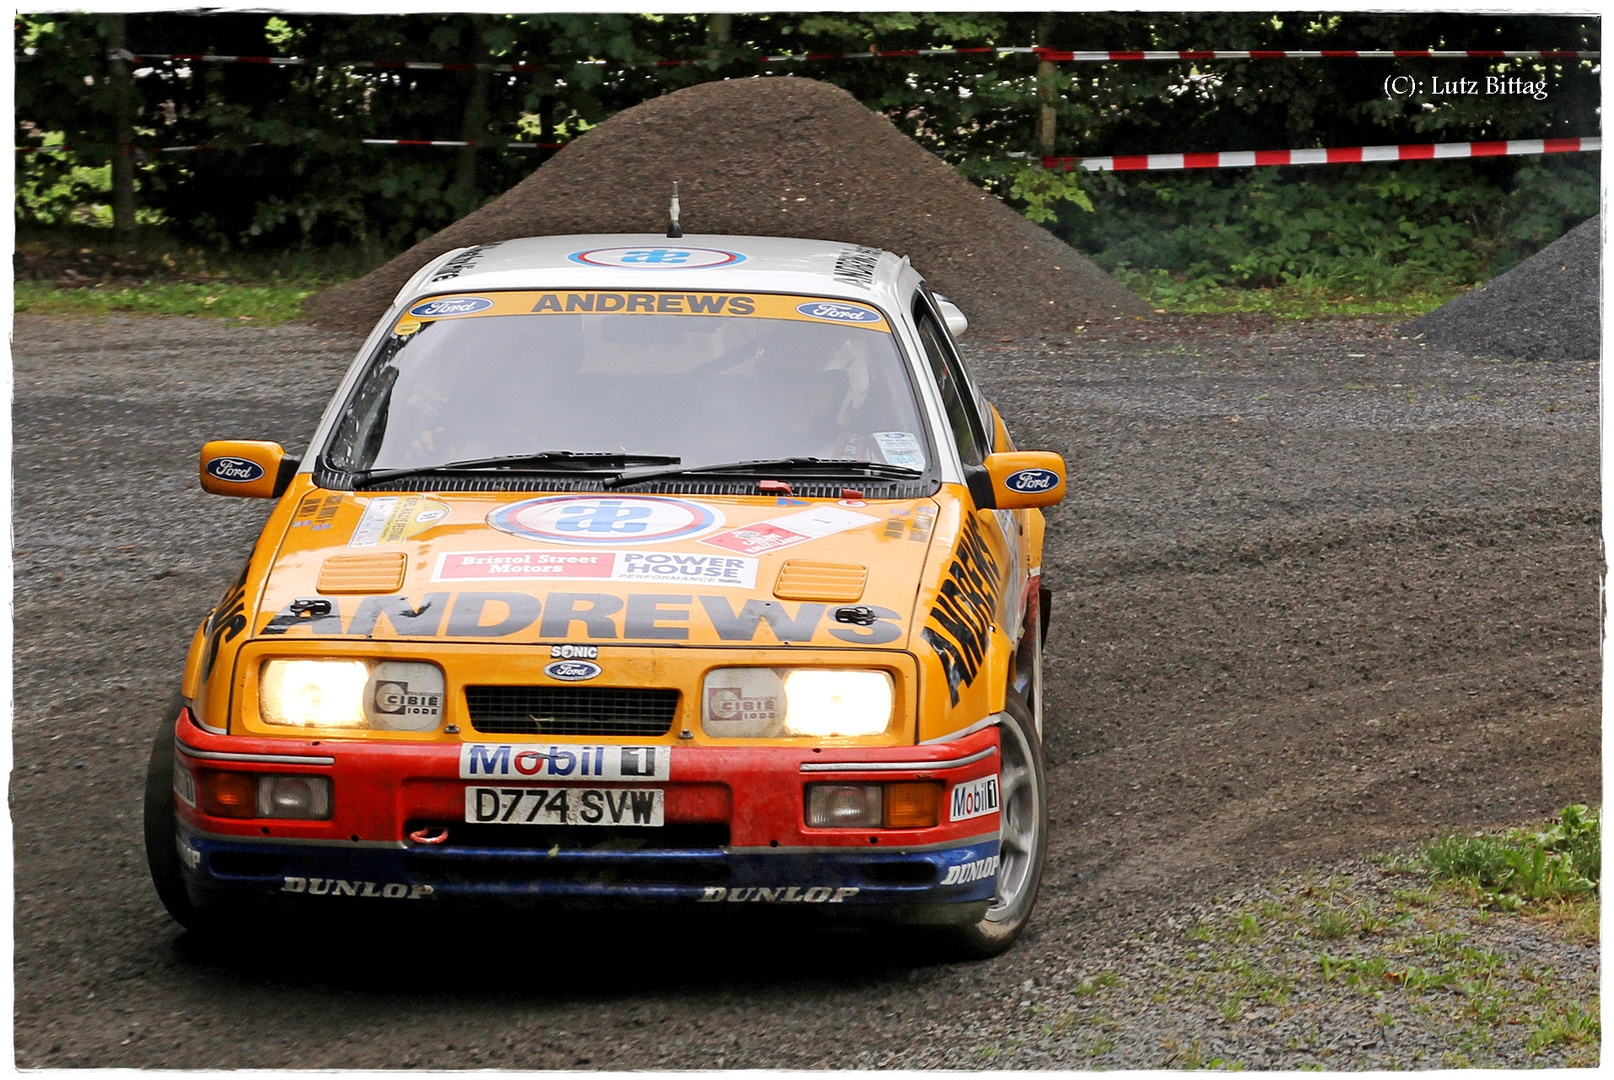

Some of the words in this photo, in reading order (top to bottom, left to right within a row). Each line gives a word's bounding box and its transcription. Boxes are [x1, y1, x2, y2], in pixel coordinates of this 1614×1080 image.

[423, 299, 477, 315] Ford
[530, 293, 756, 316] ANDREWS
[812, 302, 866, 321] Ford
[215, 459, 253, 479] Ford
[1015, 471, 1051, 490] Ford
[461, 553, 533, 567] Bristol
[538, 554, 599, 565] Street
[488, 562, 564, 575] Motors
[624, 553, 746, 570] POWER
[617, 574, 717, 583] PERFORMANCE
[626, 563, 740, 579] HOUSE
[260, 592, 903, 644] ANDREWS
[921, 510, 1001, 709] ANDREWS
[551, 644, 598, 659] SONIC
[556, 663, 588, 676] Ford
[407, 707, 438, 715] IODE
[469, 745, 604, 776] Mobil
[625, 747, 651, 775] 1
[475, 788, 570, 823] D774
[580, 790, 655, 824] SVW
[941, 854, 999, 885] DUNLOP
[281, 876, 434, 900] DUNLOP
[697, 886, 860, 903] DUNLOP
